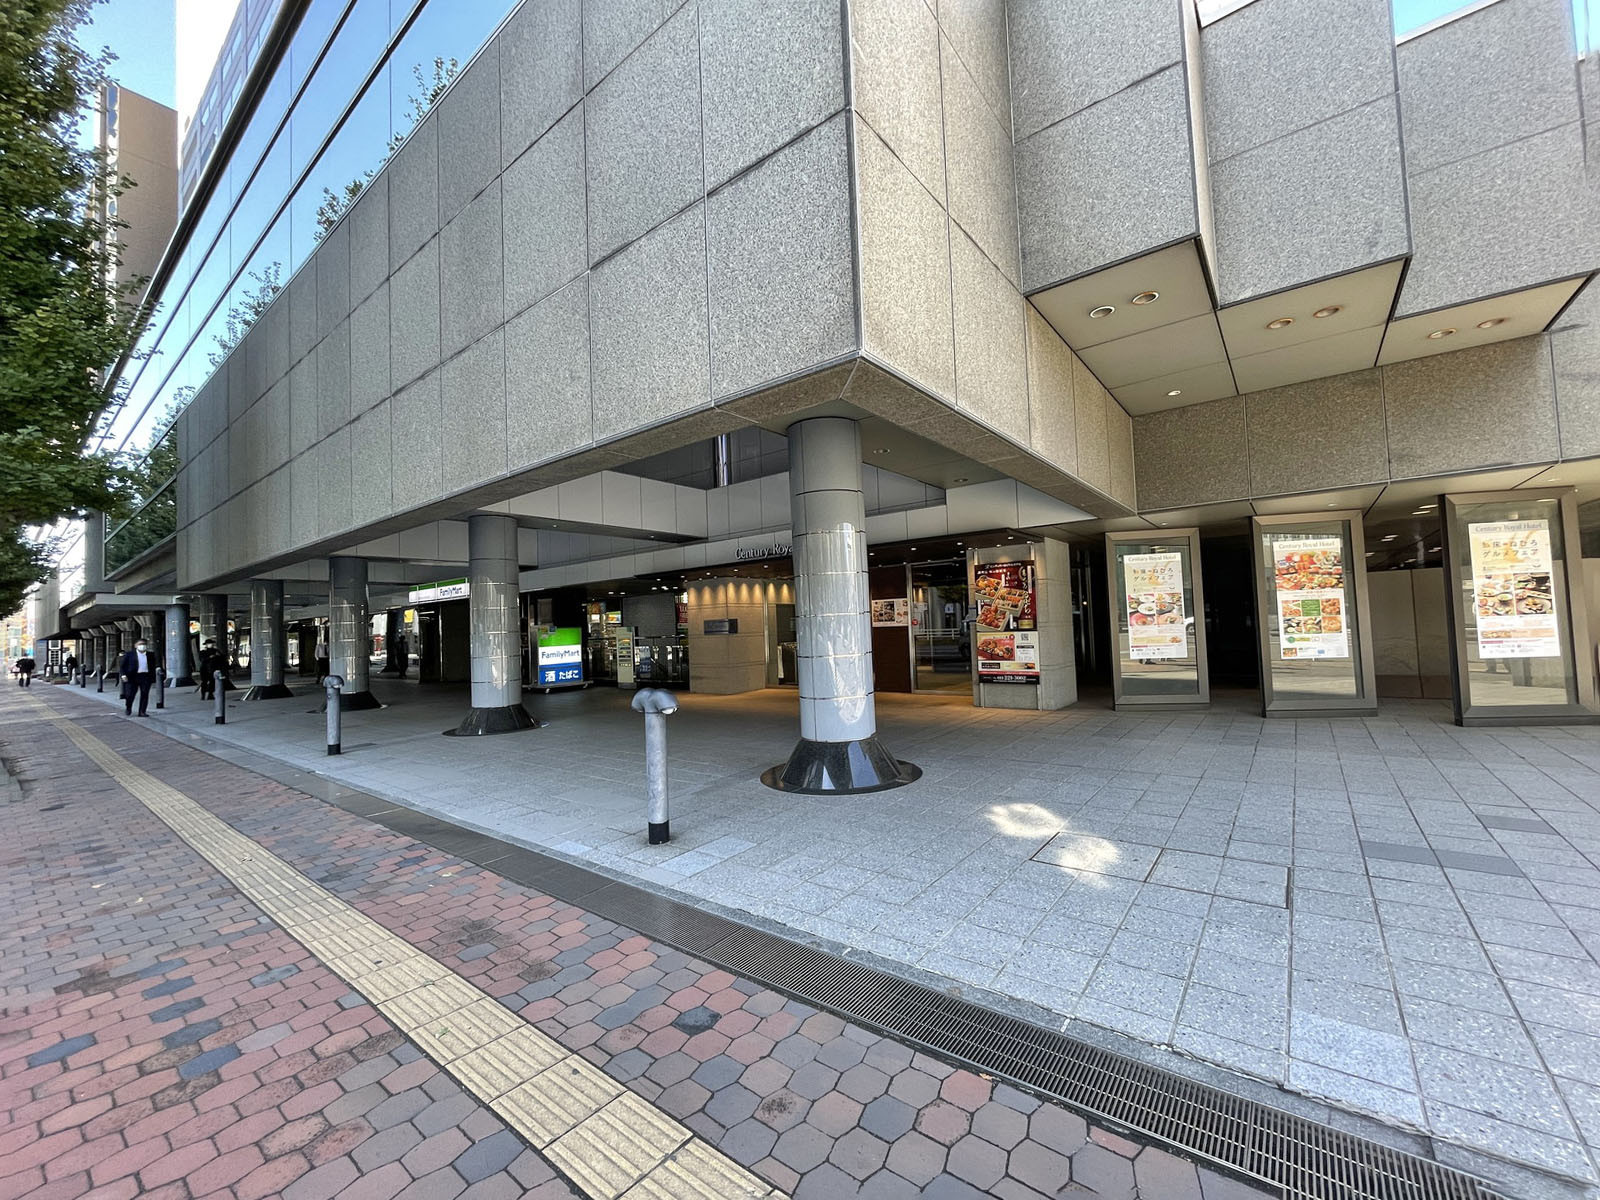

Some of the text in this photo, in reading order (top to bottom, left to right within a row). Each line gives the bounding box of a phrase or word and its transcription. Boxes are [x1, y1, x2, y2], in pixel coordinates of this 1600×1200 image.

[735, 547, 770, 559] Century
[440, 586, 462, 598] FamilyMart
[542, 650, 580, 659] FamilyMart
[545, 670, 579, 682] 酒 たばこ
